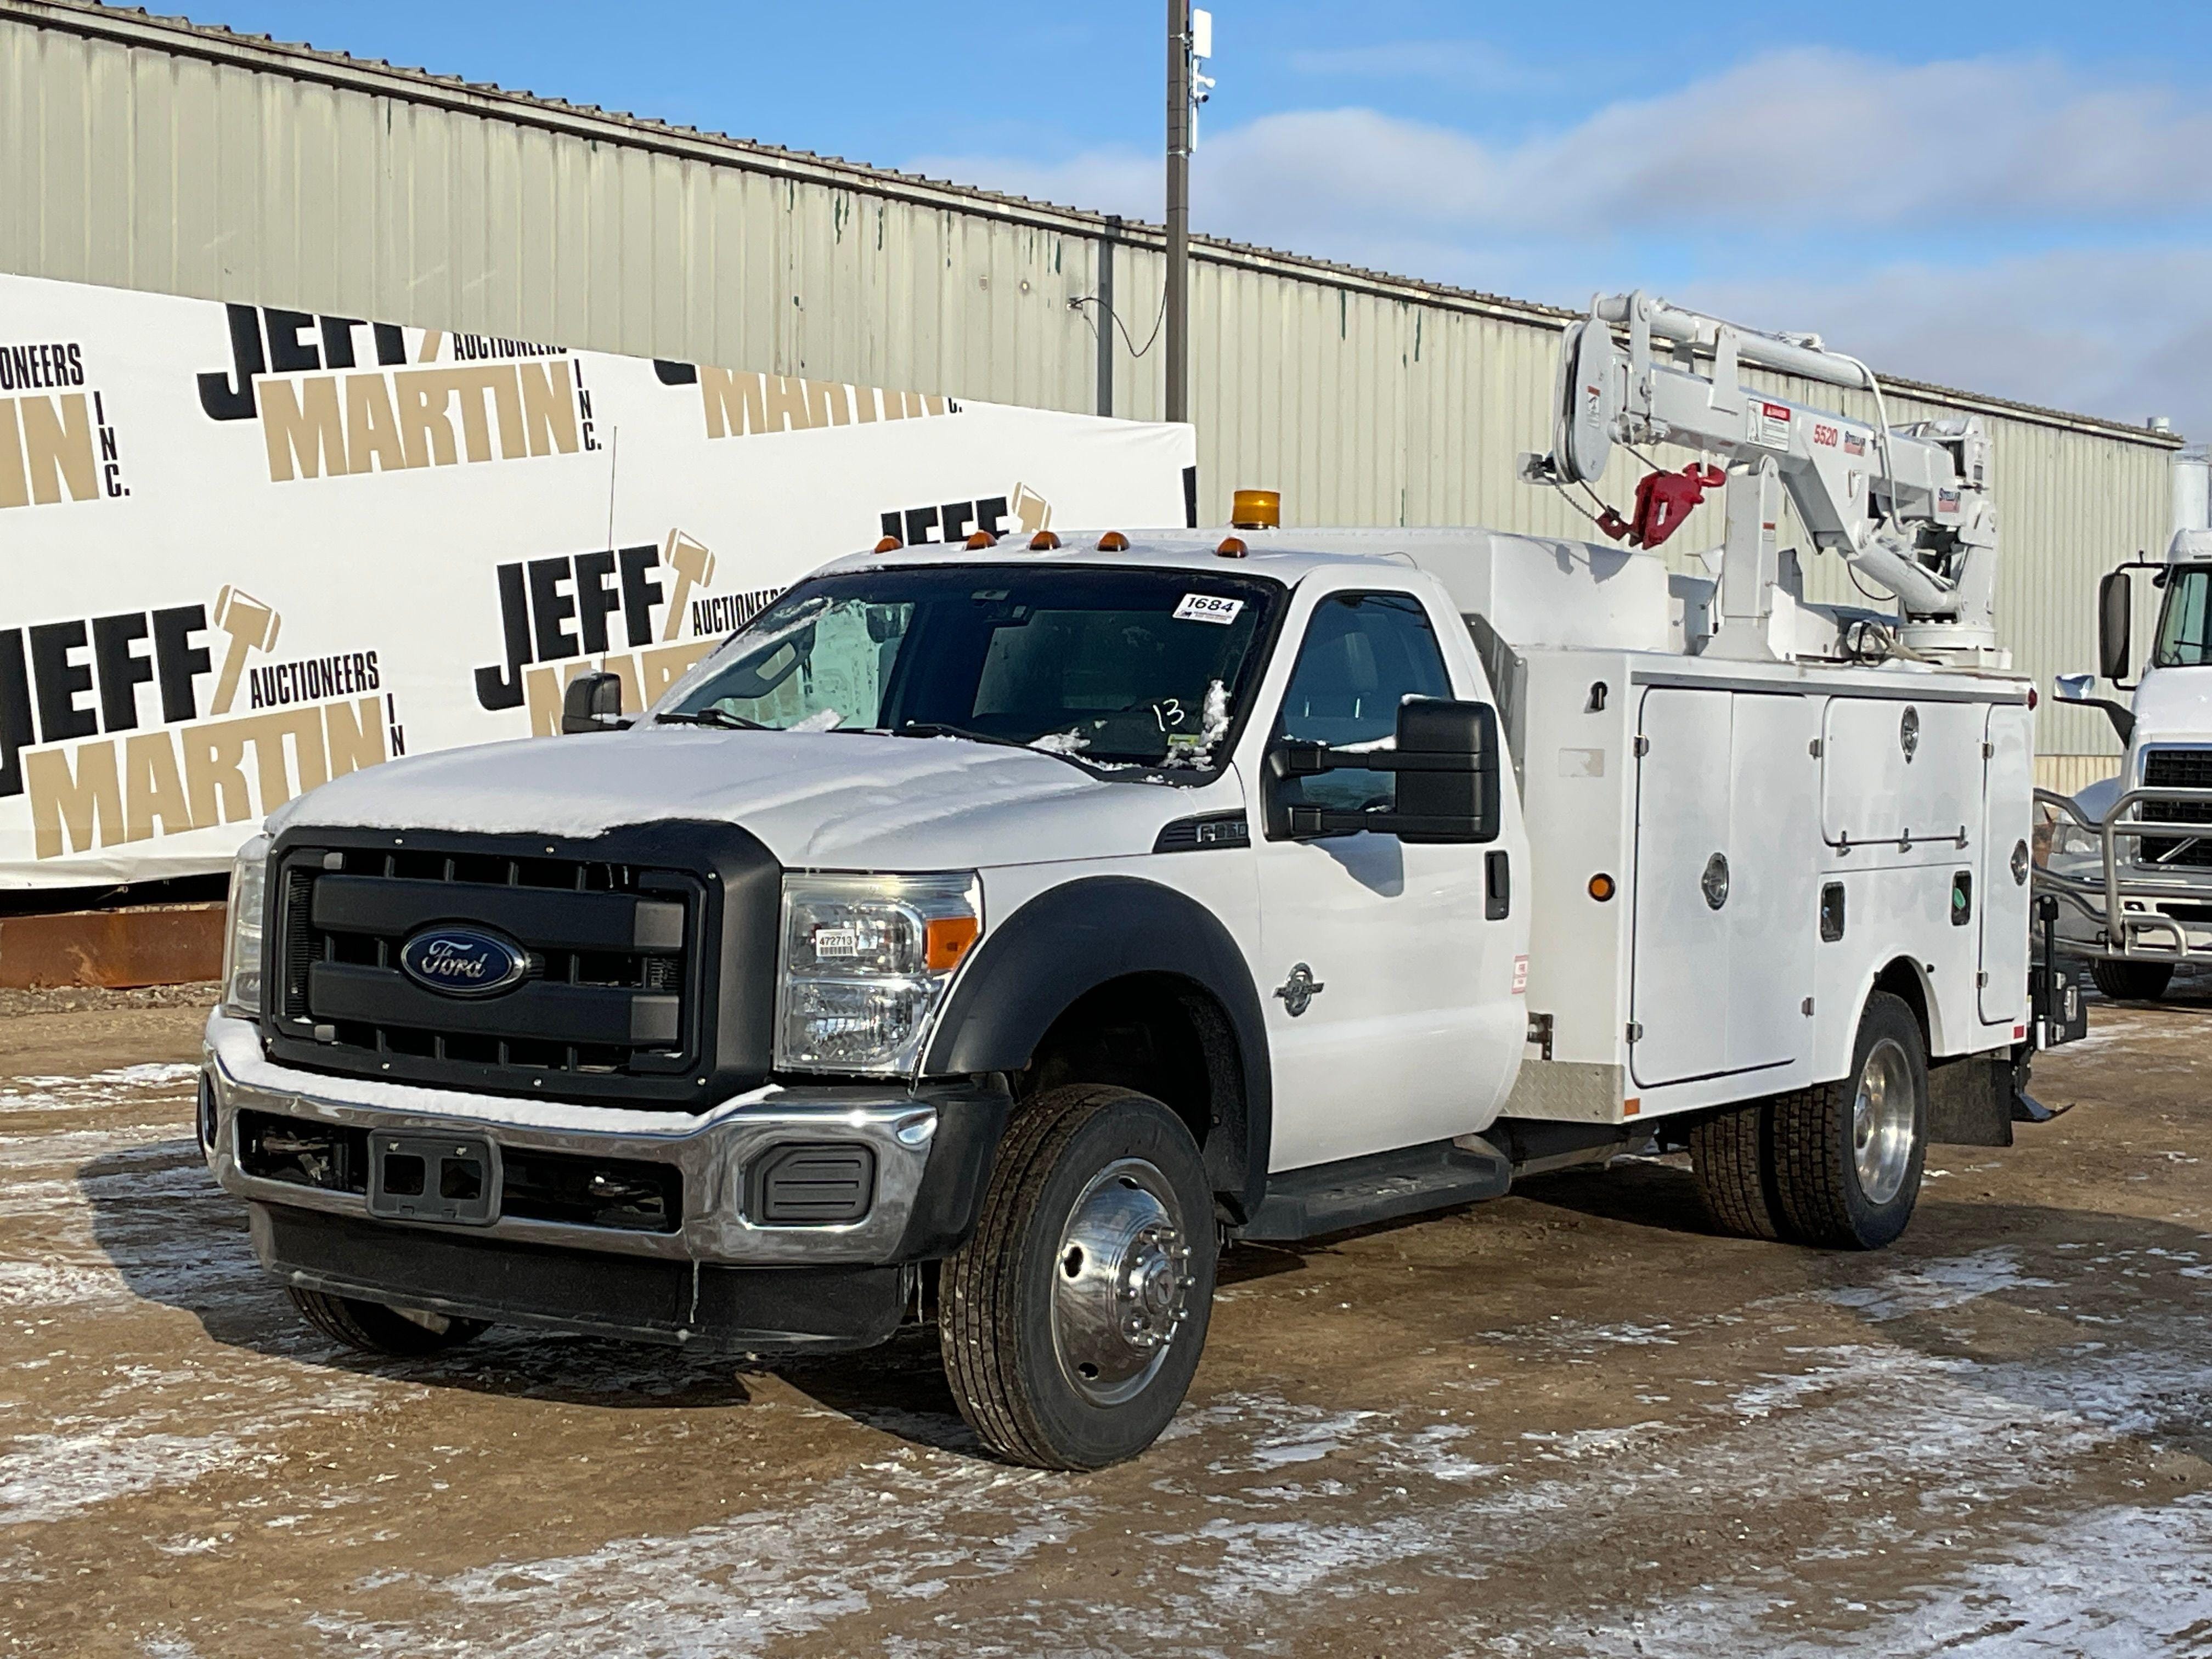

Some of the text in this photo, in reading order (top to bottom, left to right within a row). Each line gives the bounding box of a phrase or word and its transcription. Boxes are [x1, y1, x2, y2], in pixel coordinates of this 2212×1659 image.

[257, 360, 579, 482] MARTIN
[1813, 424, 1838, 447] 5520
[475, 544, 663, 711] JEFF
[693, 587, 787, 636] AUCTIONE
[1188, 597, 1234, 612] 1684
[250, 651, 380, 709] AUCTIONEERS
[387, 693, 405, 757] IN
[1153, 698, 1184, 731] 13
[26, 696, 386, 860] MARTIN
[421, 940, 488, 978] Ford
[819, 936, 853, 945] 472713
